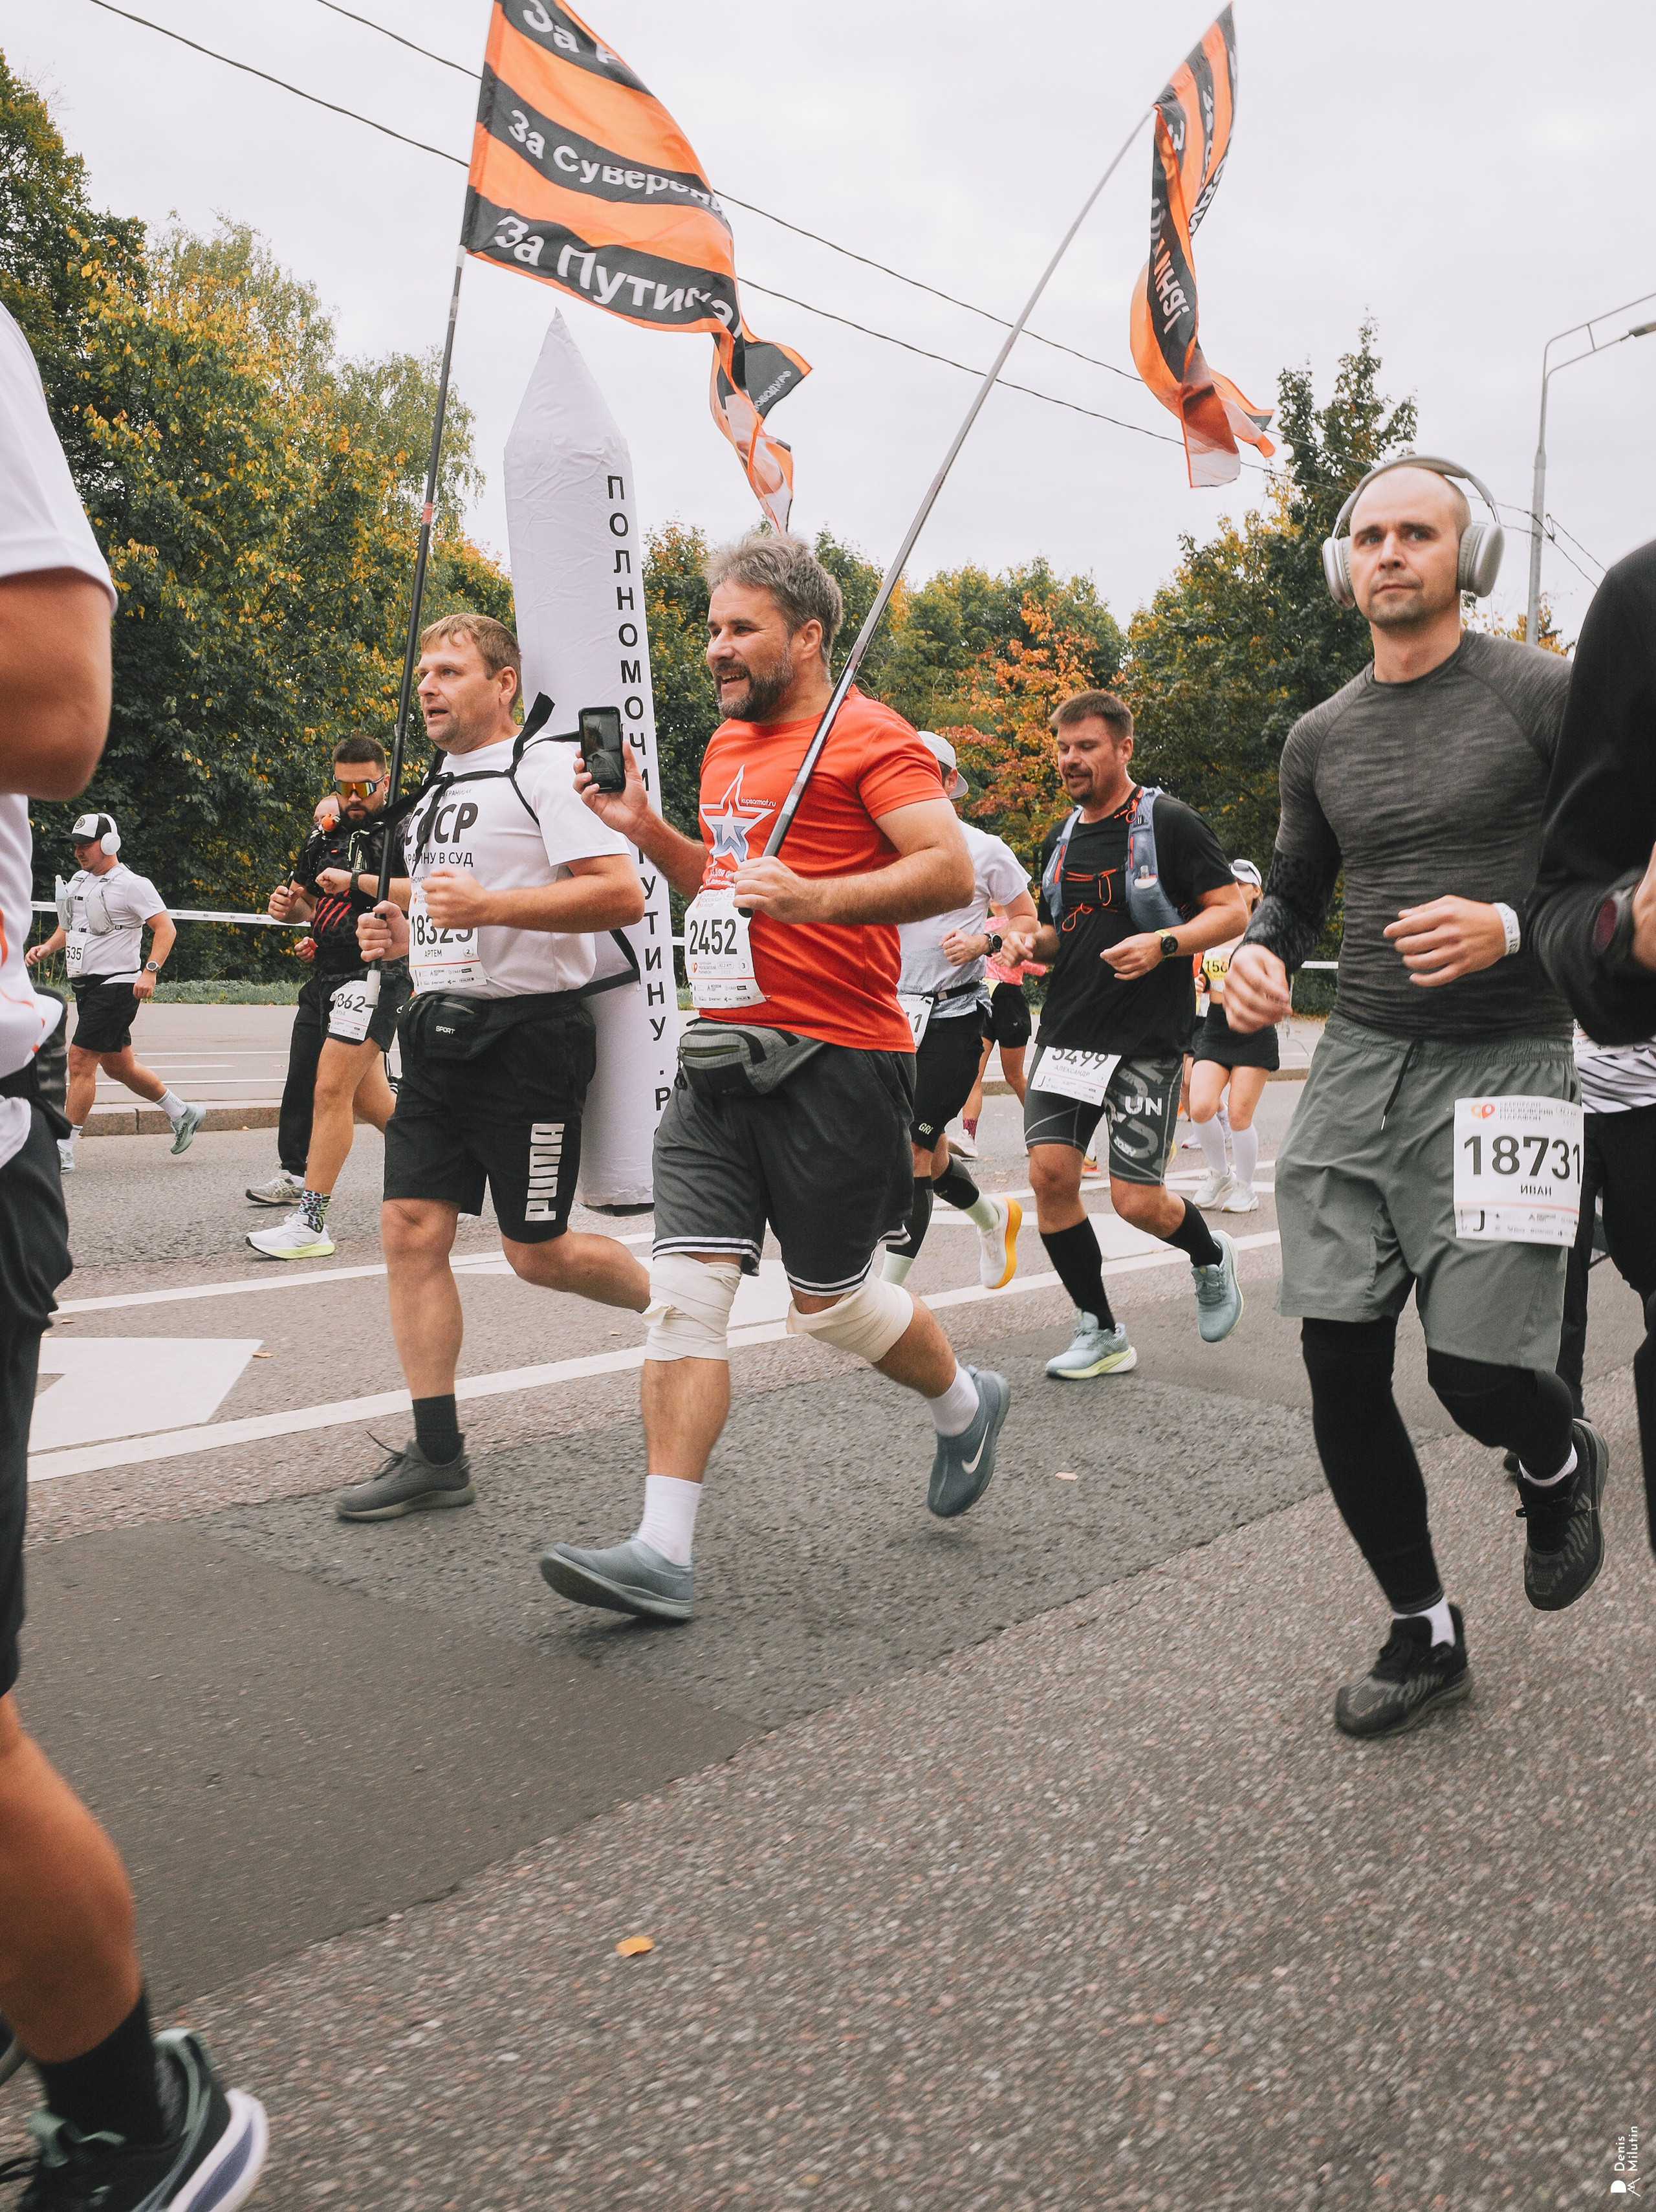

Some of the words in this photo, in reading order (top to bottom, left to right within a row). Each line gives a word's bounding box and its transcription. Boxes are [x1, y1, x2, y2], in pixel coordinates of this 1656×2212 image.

[508, 109, 543, 159] За
[494, 215, 539, 266] За
[439, 852, 446, 865] В
[448, 851, 474, 868] СУД
[690, 919, 738, 956] 2452
[424, 949, 442, 958] АРТЕМ
[435, 1025, 456, 1035] SPORT
[1054, 1064, 1091, 1078] АЛЕКСАНДР
[525, 1123, 565, 1221] PUMA
[1464, 1135, 1580, 1185] 18731
[1520, 1185, 1552, 1198] ИВАН
